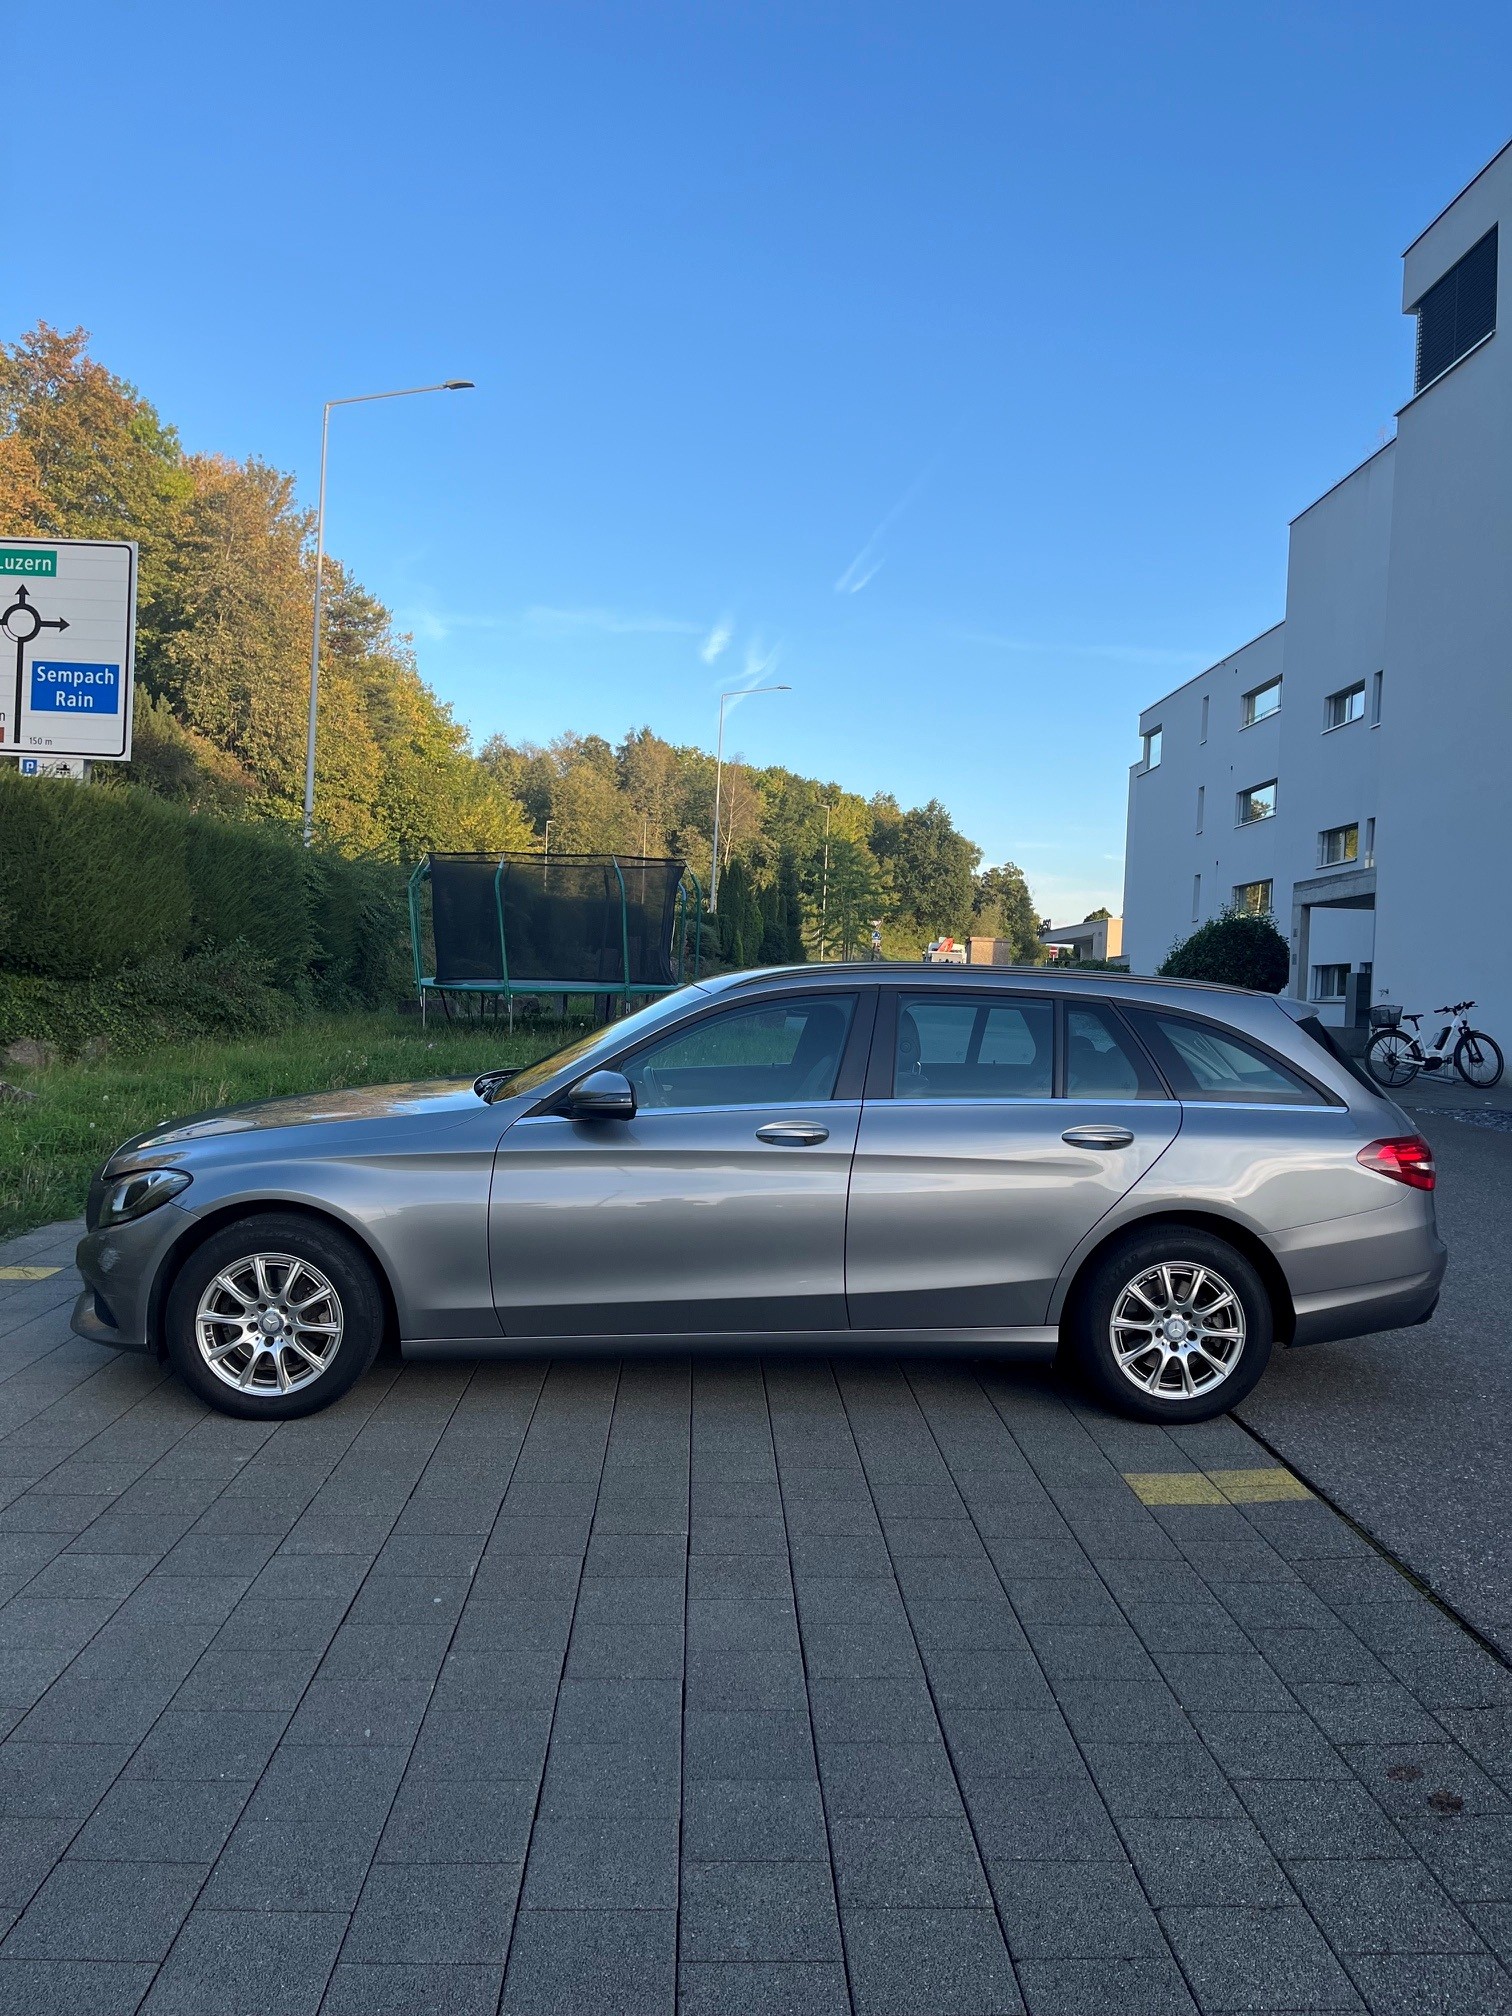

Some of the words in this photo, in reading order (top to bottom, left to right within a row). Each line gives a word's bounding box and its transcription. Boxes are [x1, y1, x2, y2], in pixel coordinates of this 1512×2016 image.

[36, 666, 114, 687] Sempach
[55, 690, 93, 708] Rain
[29, 736, 43, 745] 150
